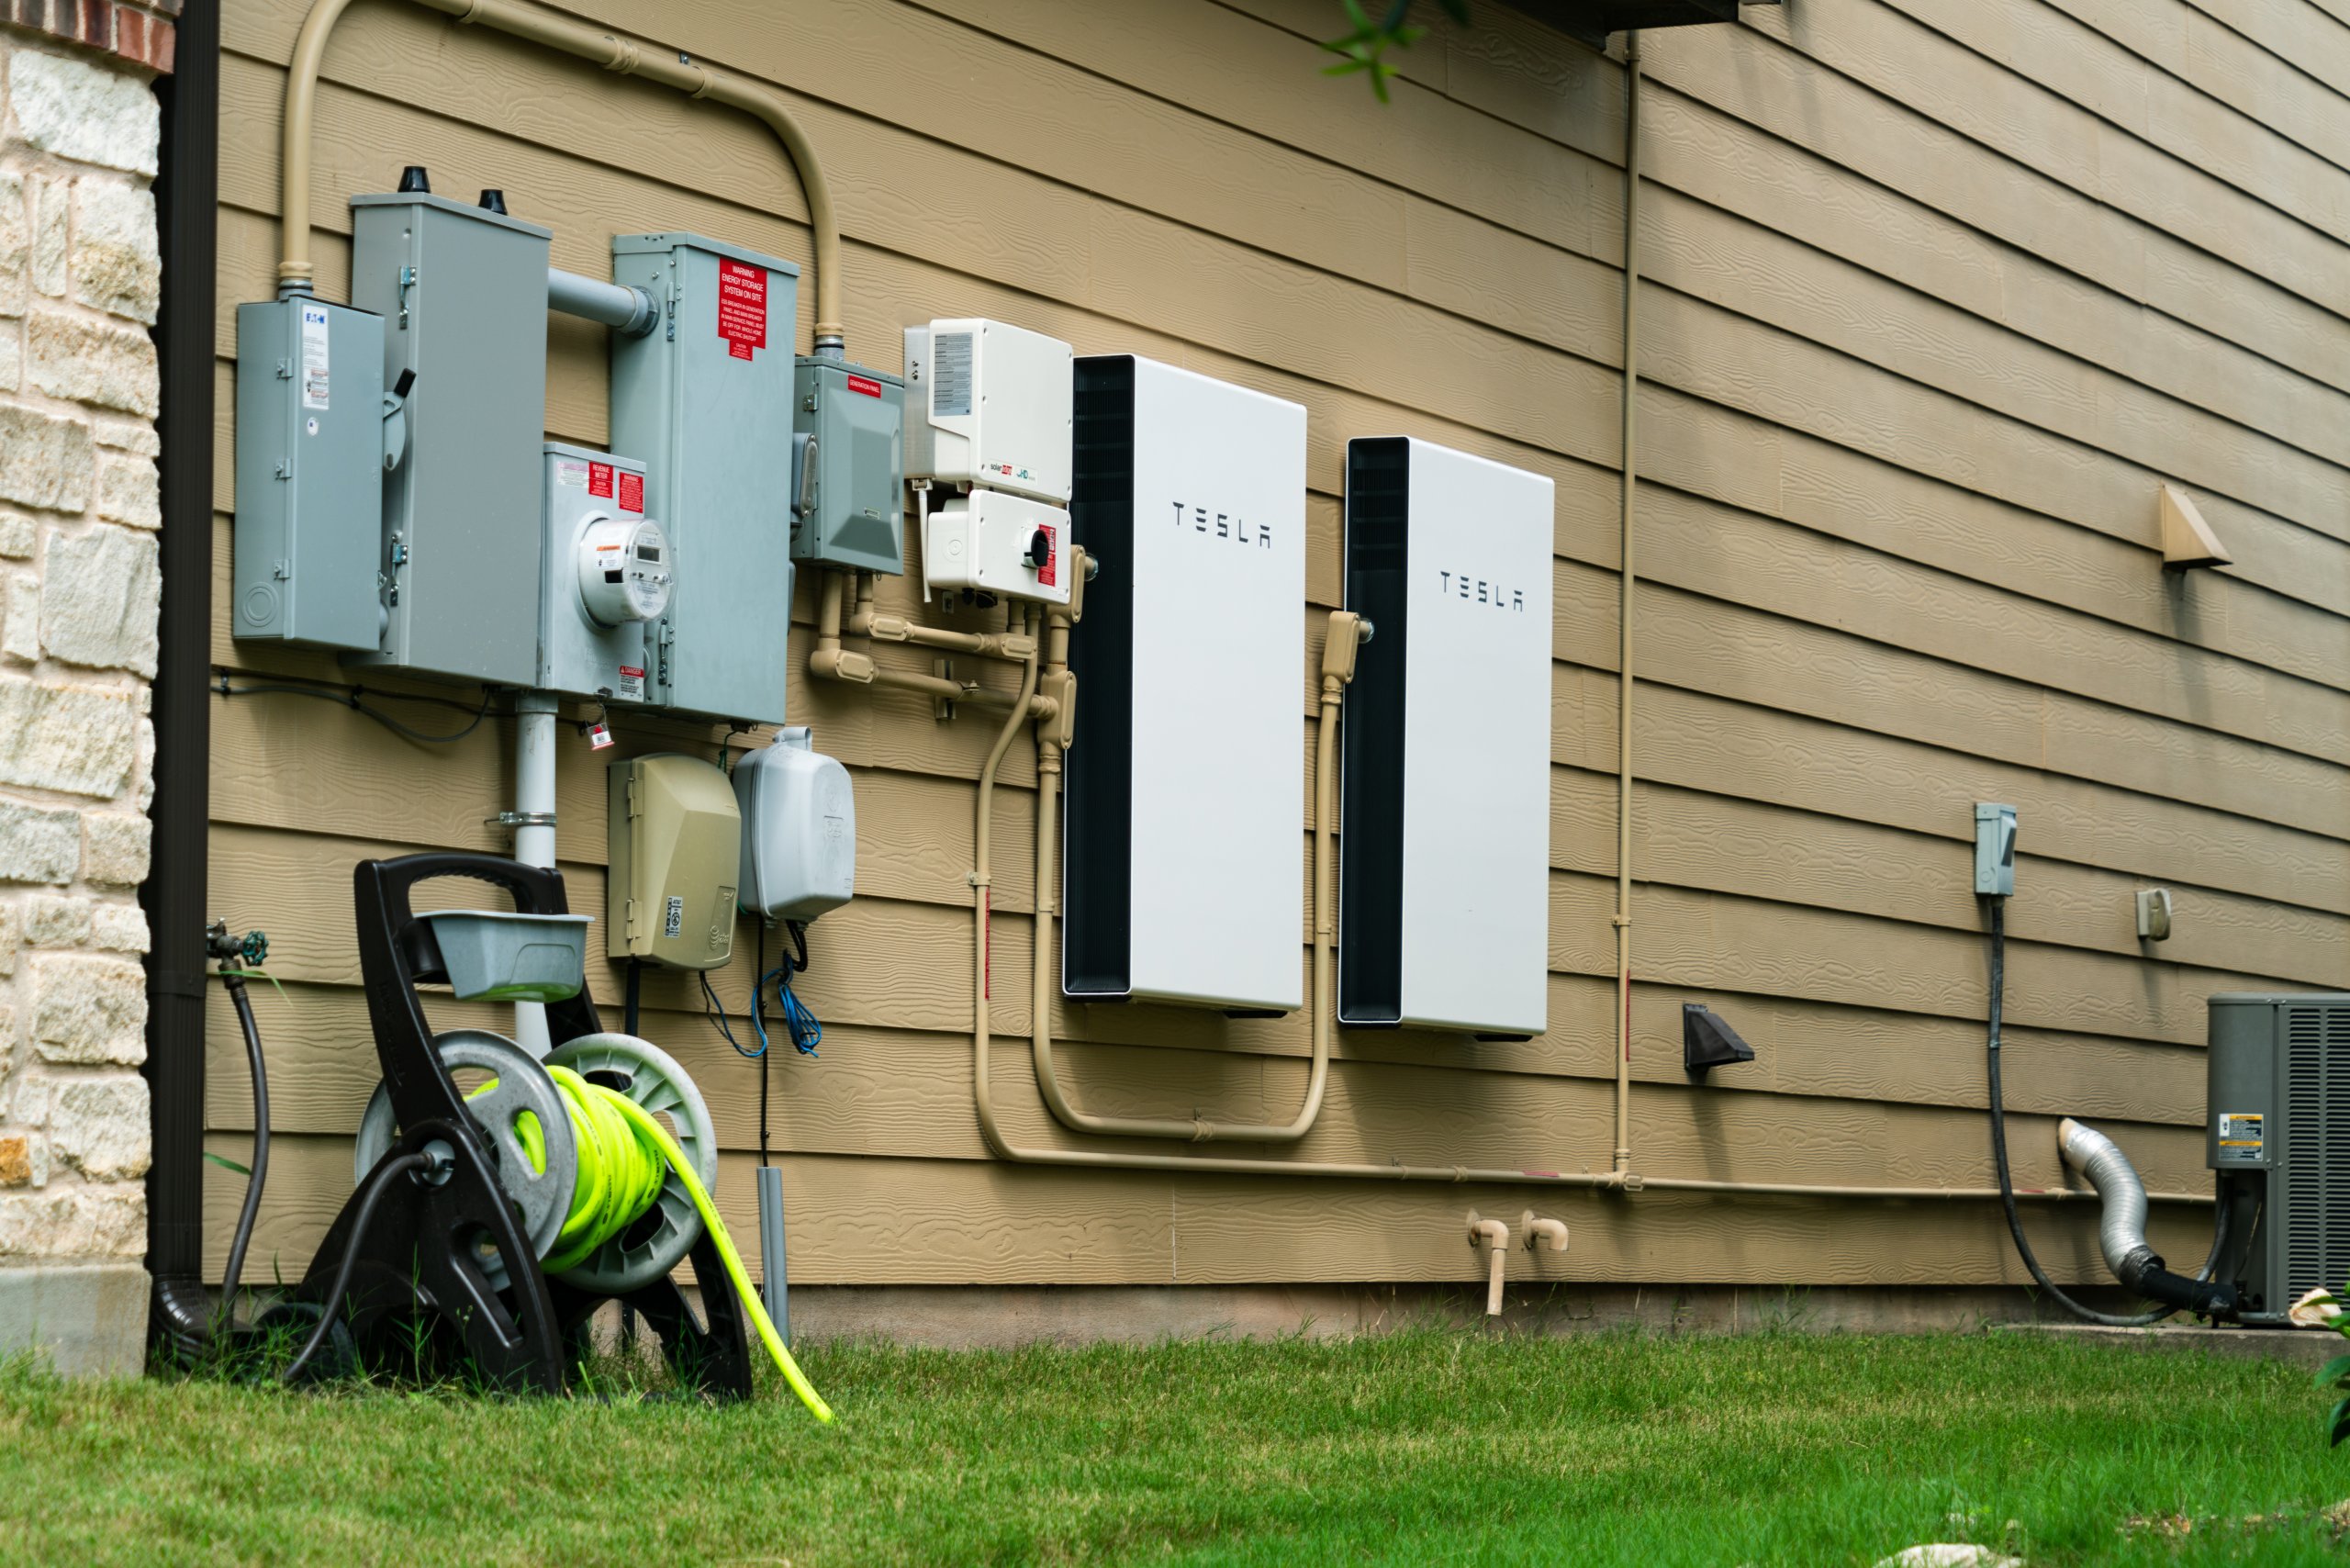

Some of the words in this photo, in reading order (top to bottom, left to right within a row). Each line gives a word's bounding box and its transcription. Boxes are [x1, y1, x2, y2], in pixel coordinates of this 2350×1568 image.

[733, 265, 755, 278] WARNING
[722, 274, 741, 285] ENERGY
[742, 278, 764, 292] STORAGE
[724, 285, 744, 297] SYSTEM
[744, 290, 752, 299] ON
[752, 293, 762, 302] SITE
[728, 299, 743, 308] BREAKER
[746, 305, 765, 315] GENERATION
[733, 316, 746, 325] SERVICE
[746, 319, 755, 328] PANEL
[748, 313, 763, 321] BREAKER
[850, 379, 870, 390] GENERATION
[870, 385, 879, 393] PANEL
[593, 464, 610, 474] REVENUE
[1173, 501, 1270, 549] TESLA
[1440, 571, 1523, 612] TESLA
[624, 666, 642, 675] DANGER
